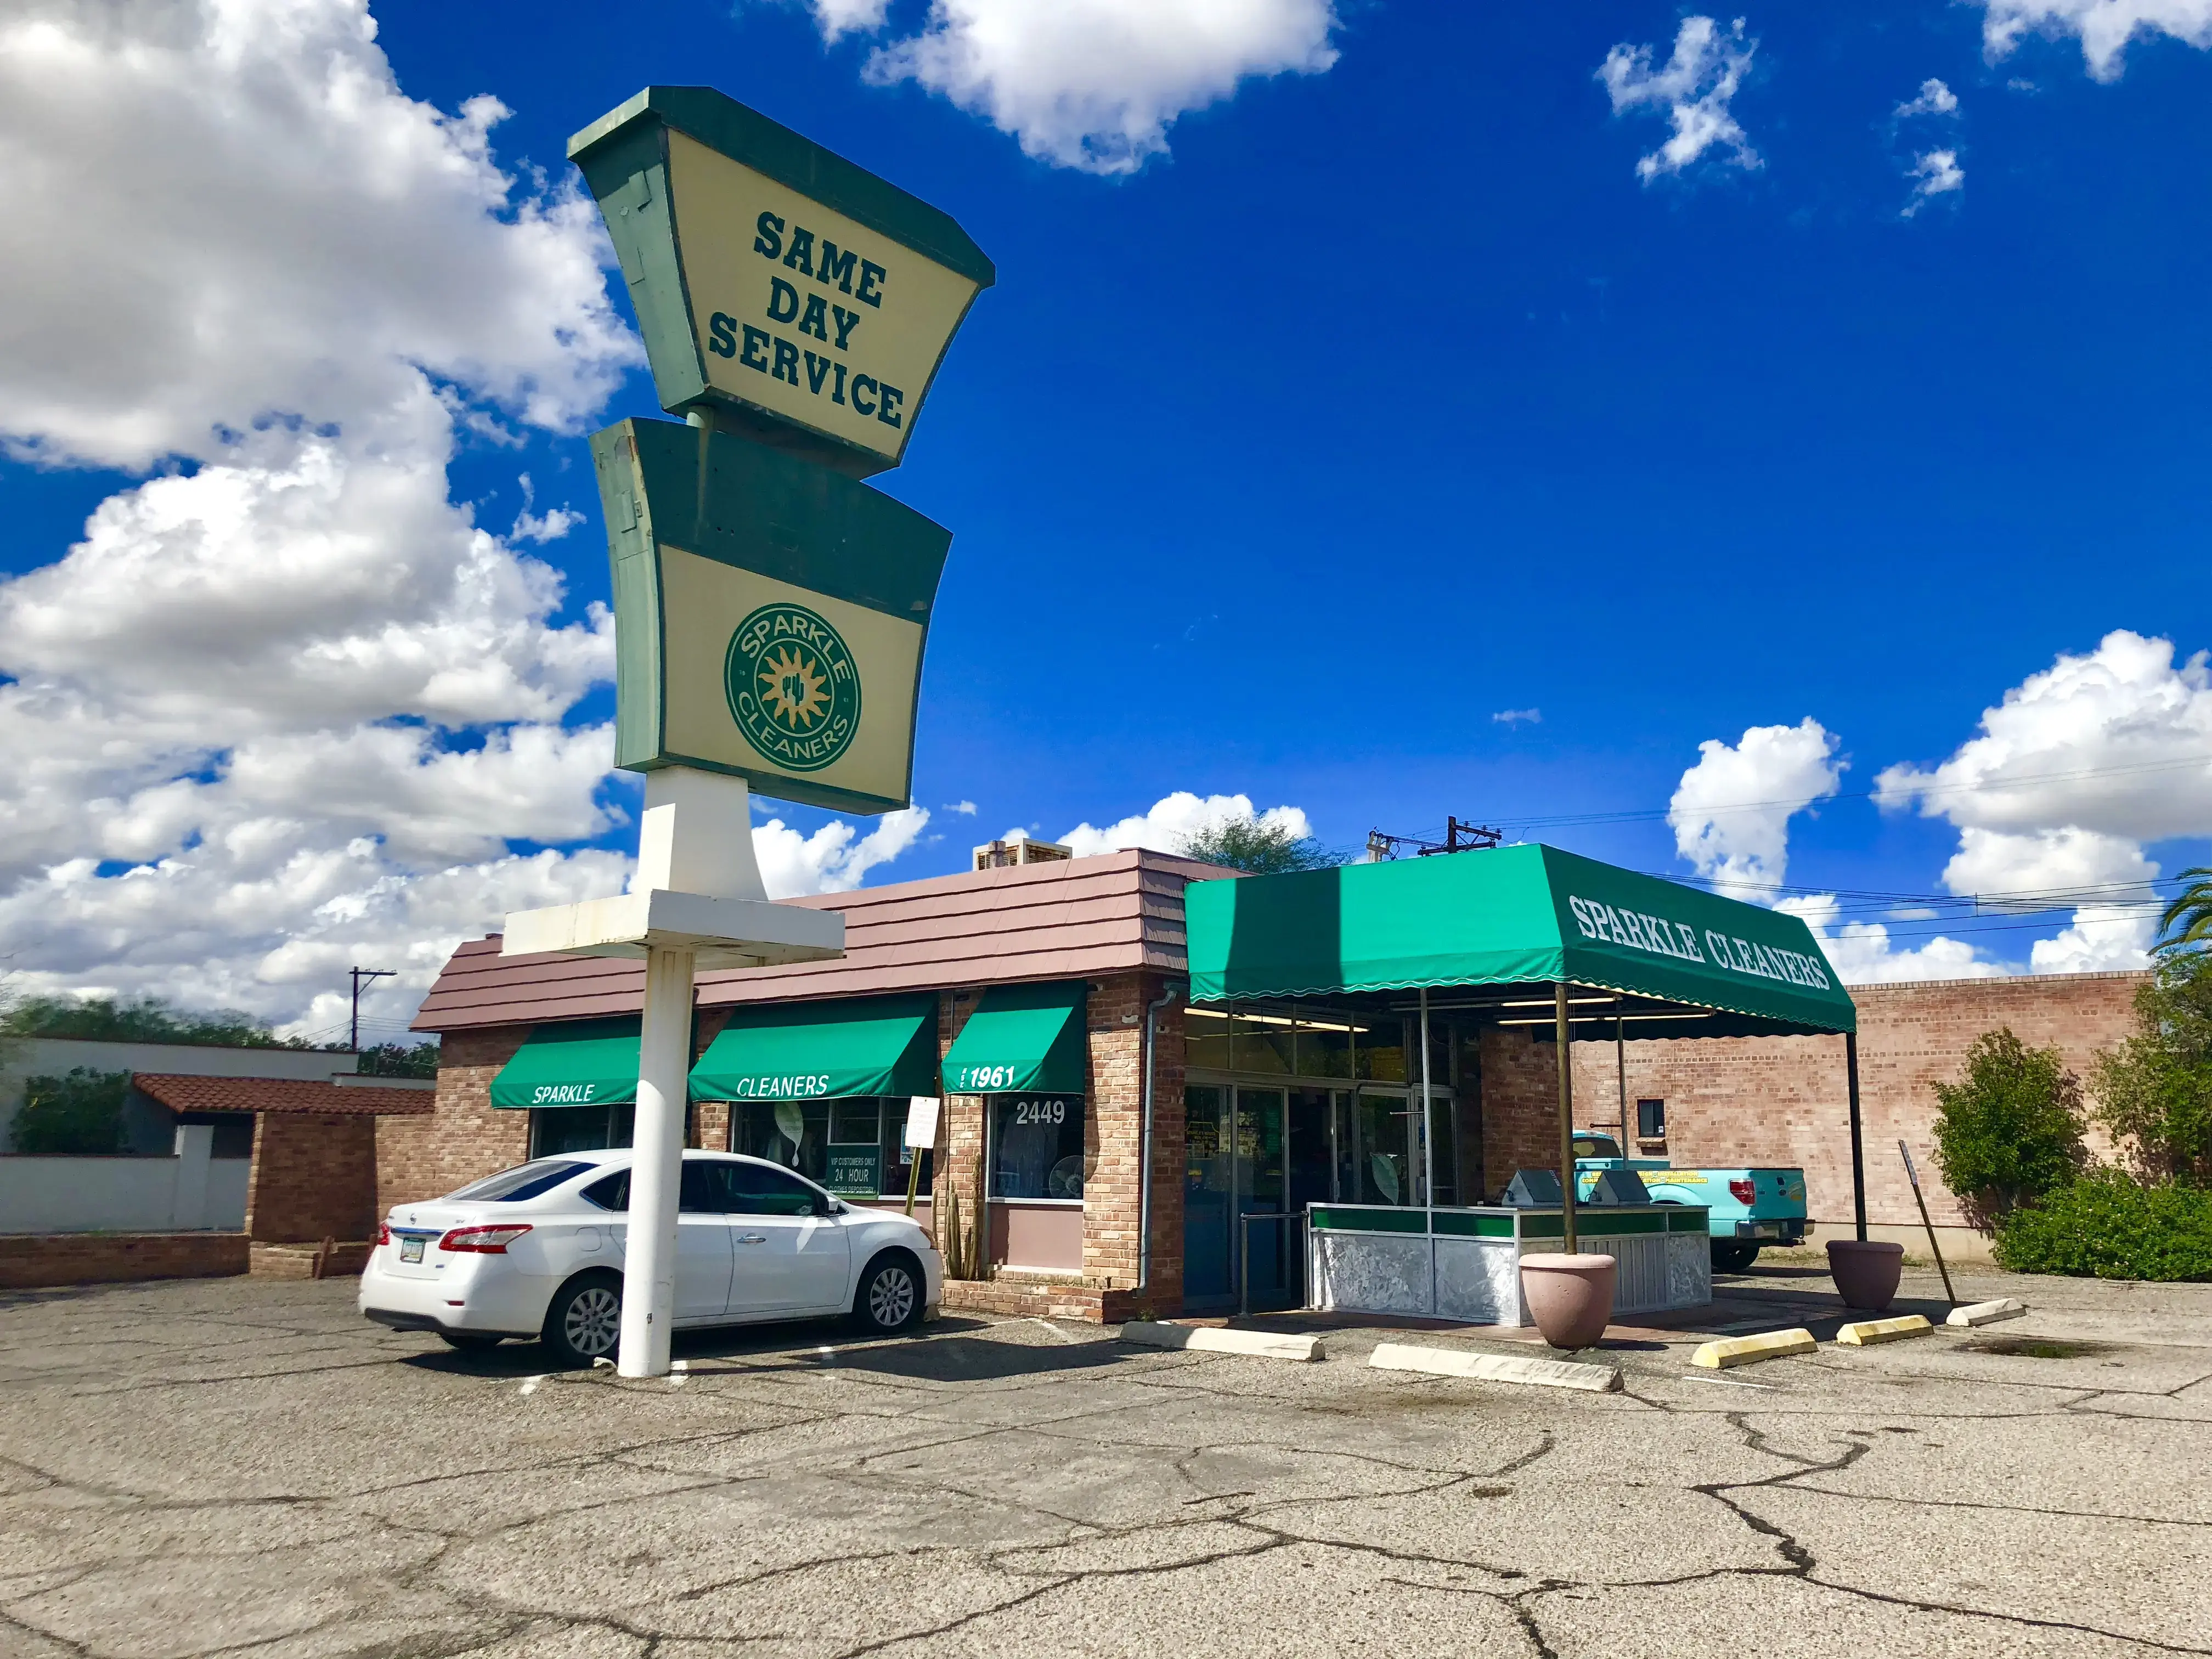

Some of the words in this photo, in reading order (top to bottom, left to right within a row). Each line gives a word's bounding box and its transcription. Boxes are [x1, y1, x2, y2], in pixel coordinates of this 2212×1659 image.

[754, 211, 887, 308] SAME
[767, 276, 860, 351] DAY
[709, 312, 904, 429] SERVICE
[741, 615, 851, 683] SPARKLE
[739, 691, 848, 759] CLEANERS
[1570, 895, 1706, 963] SPARKLE
[1706, 929, 1830, 990] CLEANERS
[532, 1084, 595, 1103] SPARKLE
[737, 1075, 829, 1097] CLEANERS
[971, 1066, 1014, 1088] 1961
[1016, 1101, 1065, 1124] 2449
[835, 1169, 843, 1182] 24
[848, 1169, 868, 1182] HOUR
